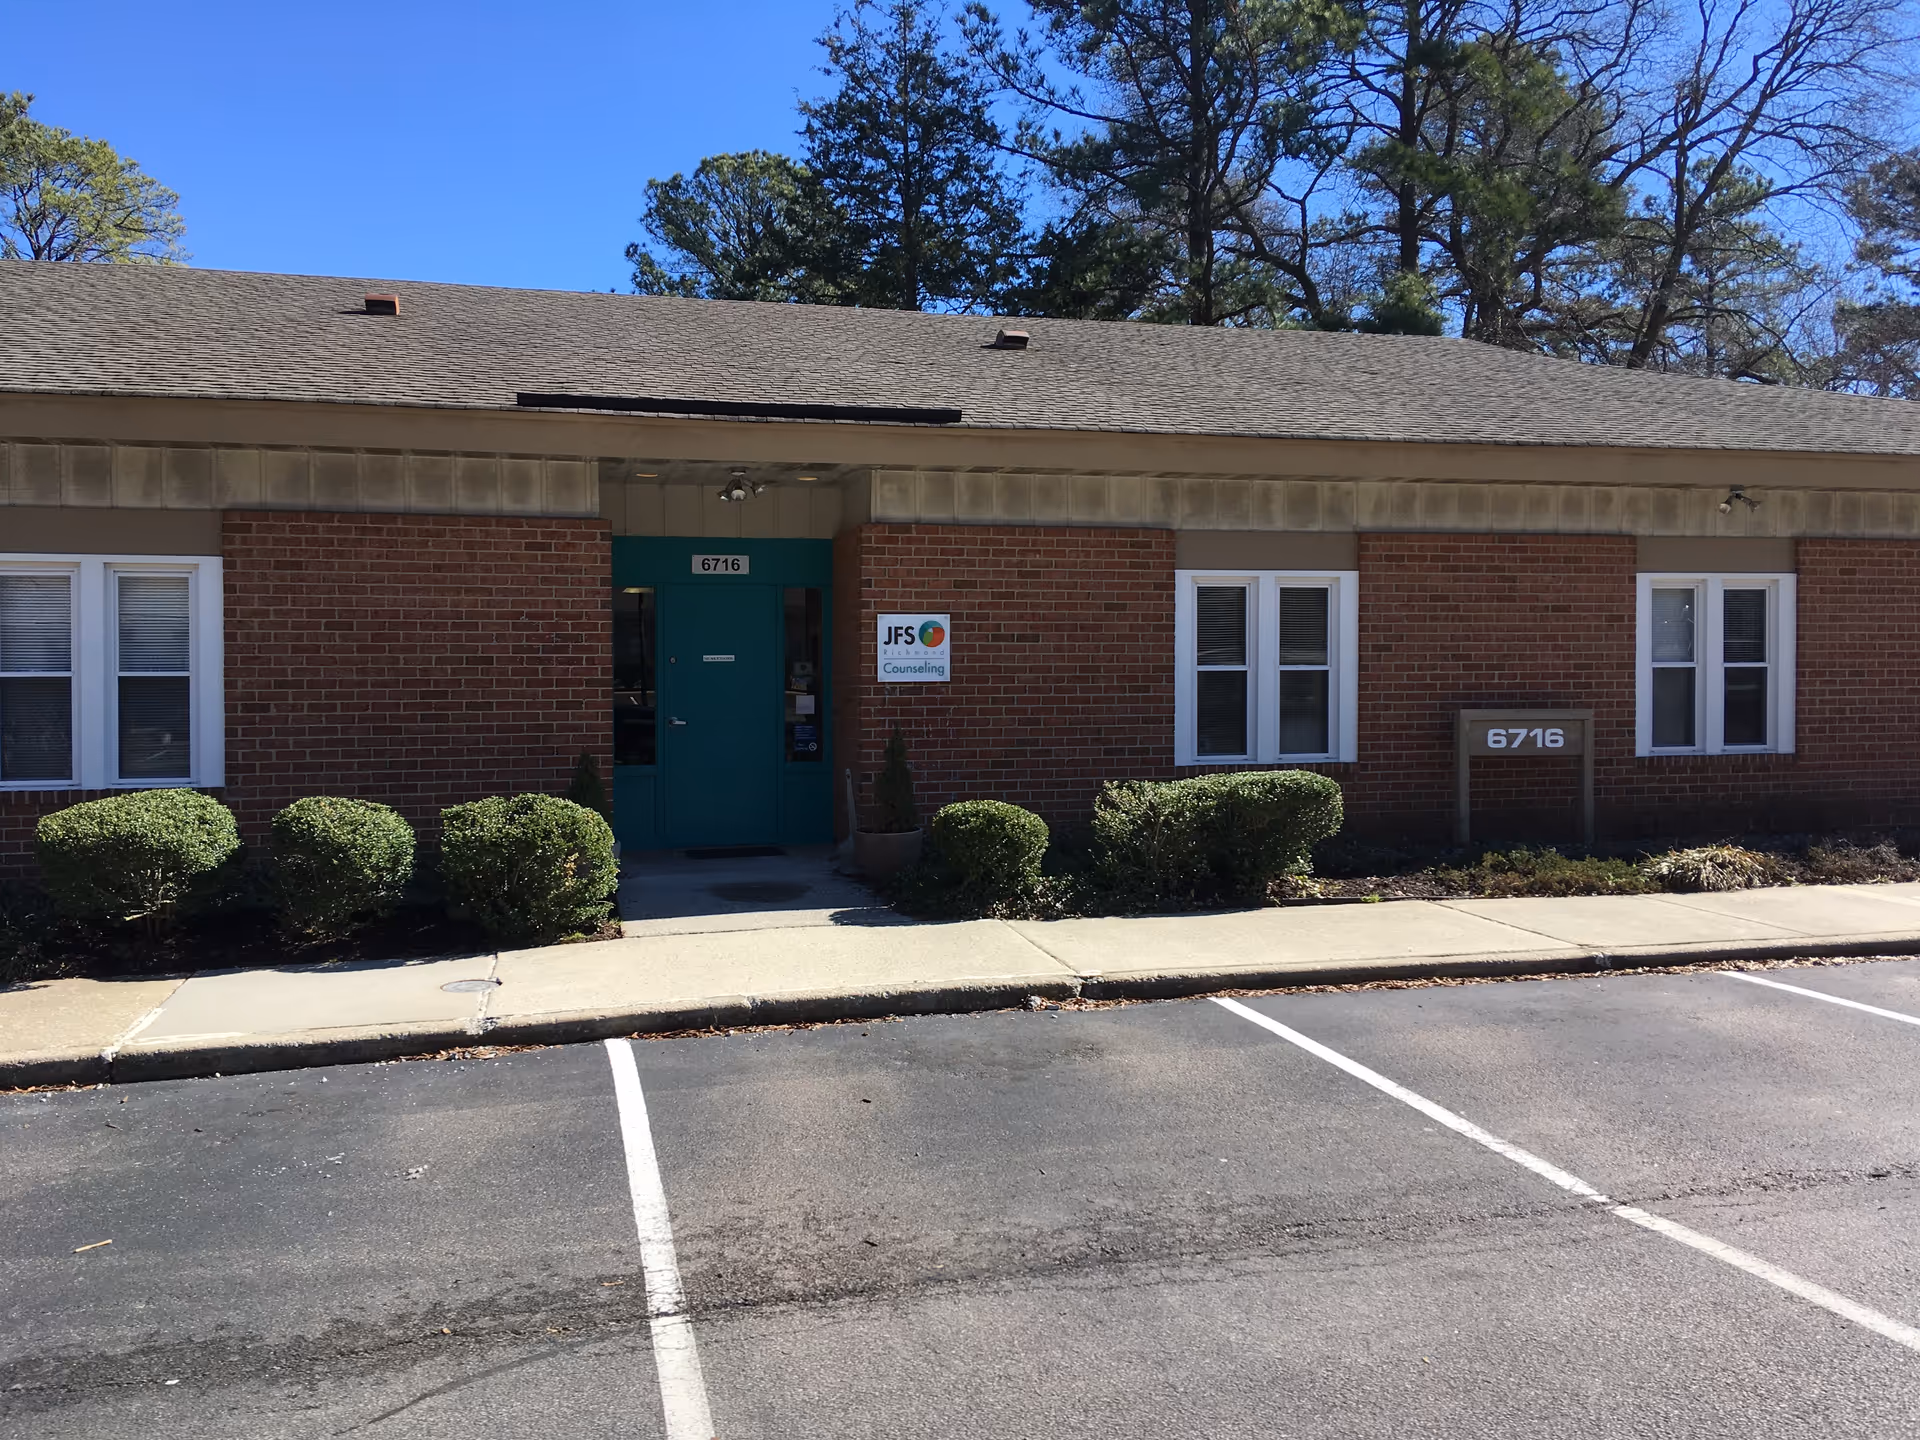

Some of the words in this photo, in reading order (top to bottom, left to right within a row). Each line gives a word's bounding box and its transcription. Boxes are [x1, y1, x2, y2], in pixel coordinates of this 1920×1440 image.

[701, 557, 740, 571] 6716
[883, 625, 916, 645] JFS
[883, 660, 945, 677] Counseling
[1487, 728, 1564, 748] 6716
